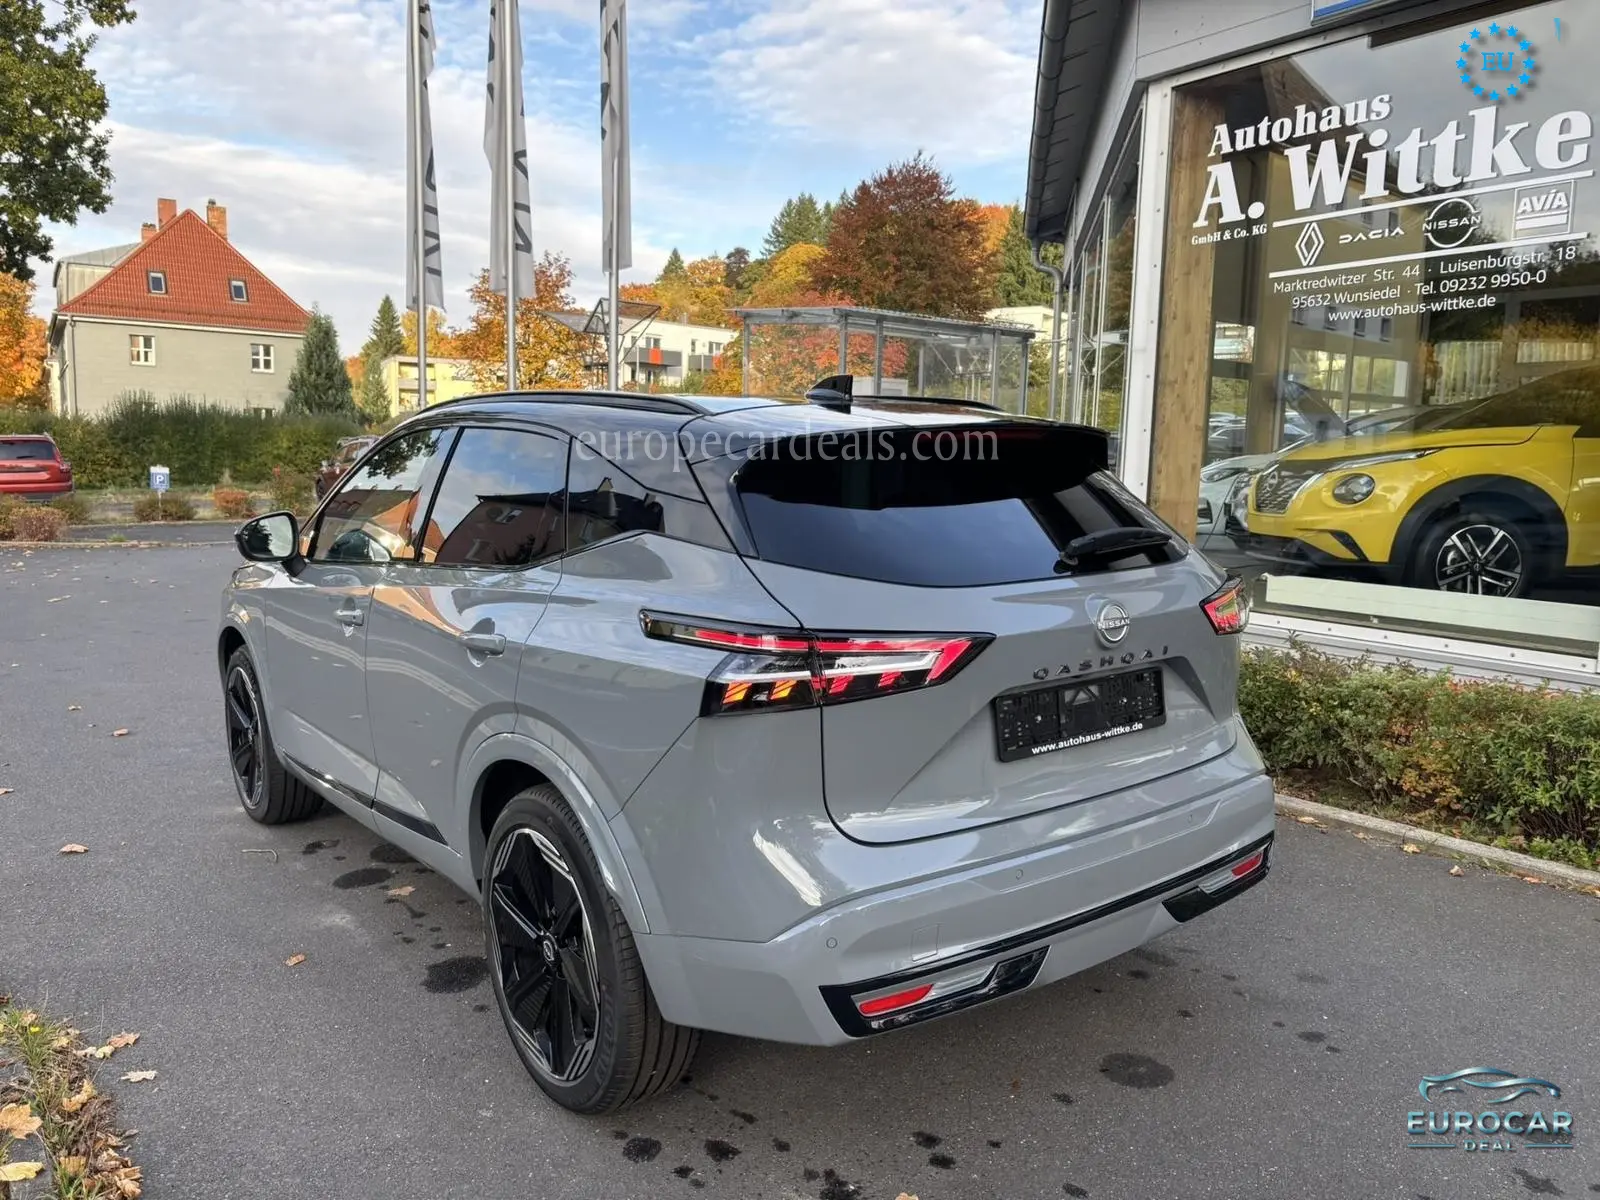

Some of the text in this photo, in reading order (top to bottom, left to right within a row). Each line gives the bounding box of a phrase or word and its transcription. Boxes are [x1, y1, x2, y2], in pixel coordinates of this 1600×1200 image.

[1207, 94, 1391, 157] Autohaus
[1193, 105, 1592, 228] A. Wittke
[1191, 224, 1268, 245] GmbH & Co. KG
[1339, 227, 1405, 244] DACIA
[1422, 215, 1481, 231] NISSAN
[1273, 245, 1576, 293] Marktredwitzer Str. 44 Luisenburgstr. 18
[1292, 270, 1547, 309] 95632 Wunsiedel Tel. 09232 9950-0
[1328, 294, 1496, 321] www.autohaus-wittke.de
[1097, 618, 1130, 631] NISSAN
[1033, 646, 1169, 680] QASHQAI
[1032, 722, 1143, 754] www.autohaus-wittke.de
